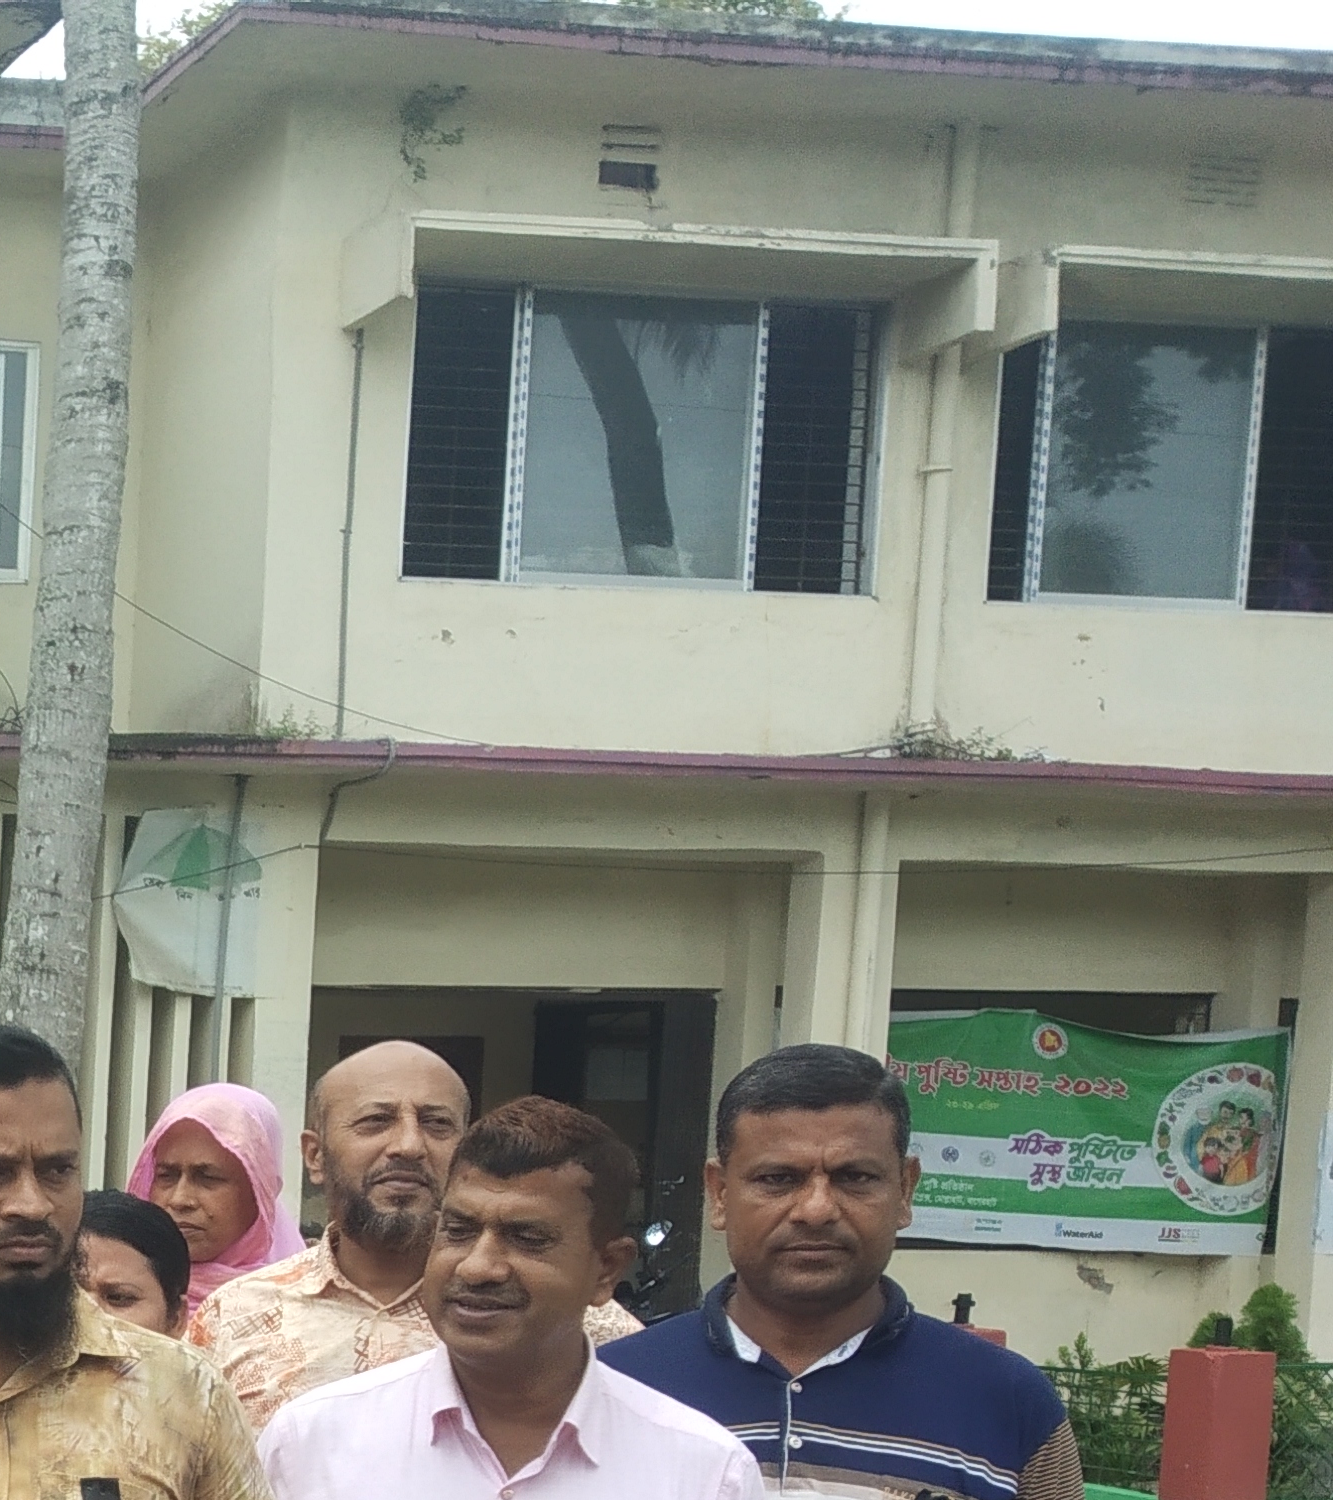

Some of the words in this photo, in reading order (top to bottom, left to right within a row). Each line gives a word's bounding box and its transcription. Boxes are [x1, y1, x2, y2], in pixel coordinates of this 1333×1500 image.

[914, 1056, 971, 1098] পুষ্টি
[1008, 1132, 1067, 1157] সঠিক
[1068, 1135, 1142, 1164] পুষ্টিতে
[1029, 1162, 1066, 1186] সুস্থ
[1066, 1160, 1127, 1185] জীবন
[1062, 1229, 1104, 1239] WaterAid
[1158, 1227, 1182, 1239] JJS
